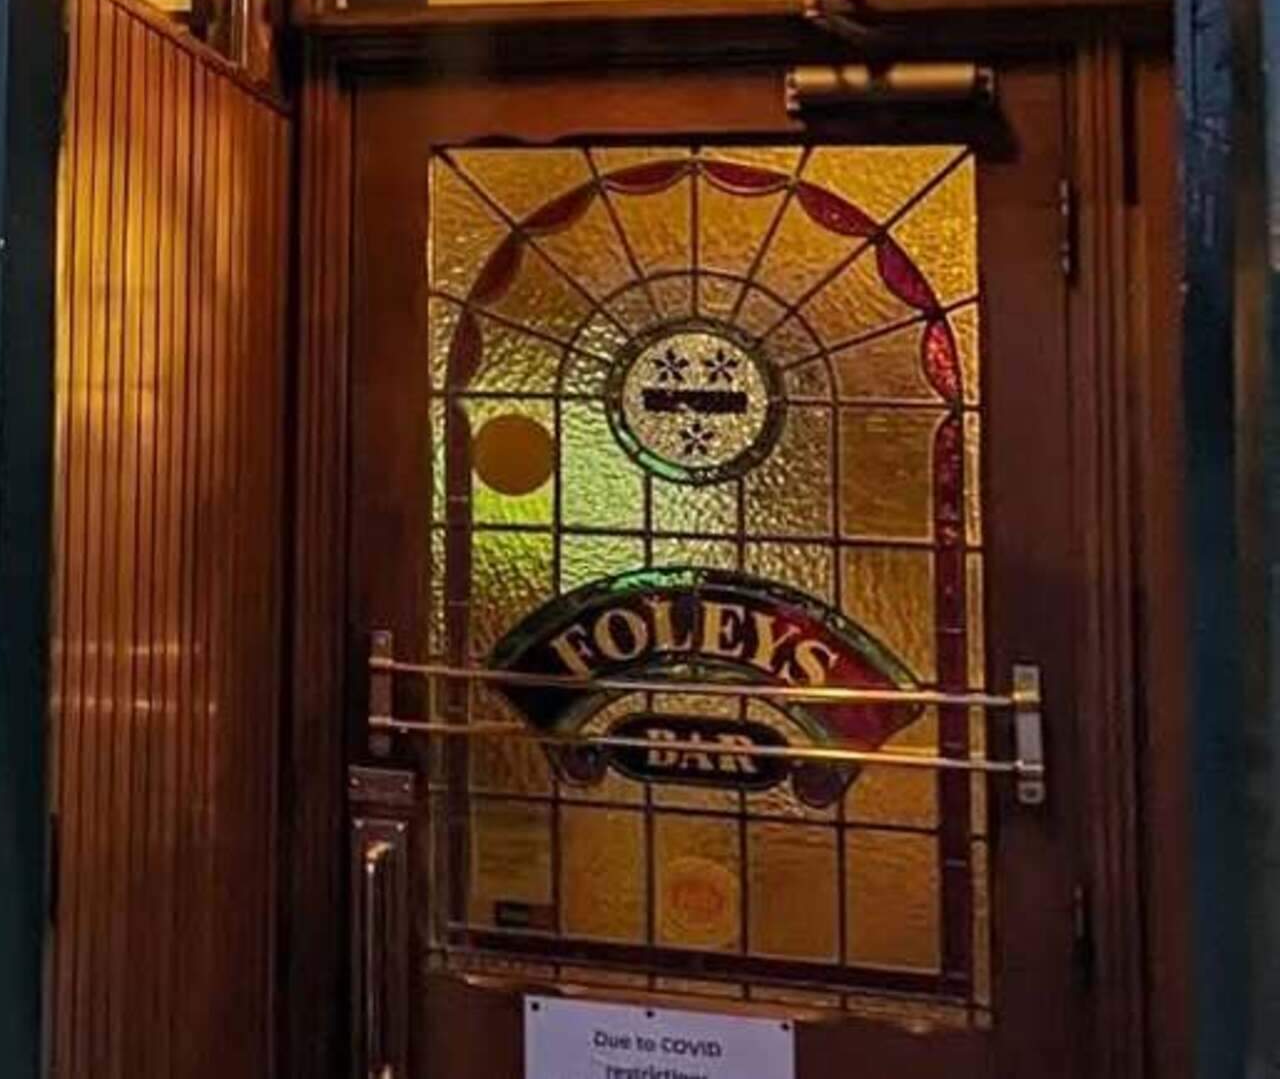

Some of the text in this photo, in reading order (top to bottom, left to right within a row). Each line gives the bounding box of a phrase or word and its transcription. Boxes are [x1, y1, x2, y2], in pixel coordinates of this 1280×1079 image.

[548, 593, 839, 688] FOLEYS
[645, 727, 758, 775] BAR
[593, 1030, 723, 1057] Due to COVID
